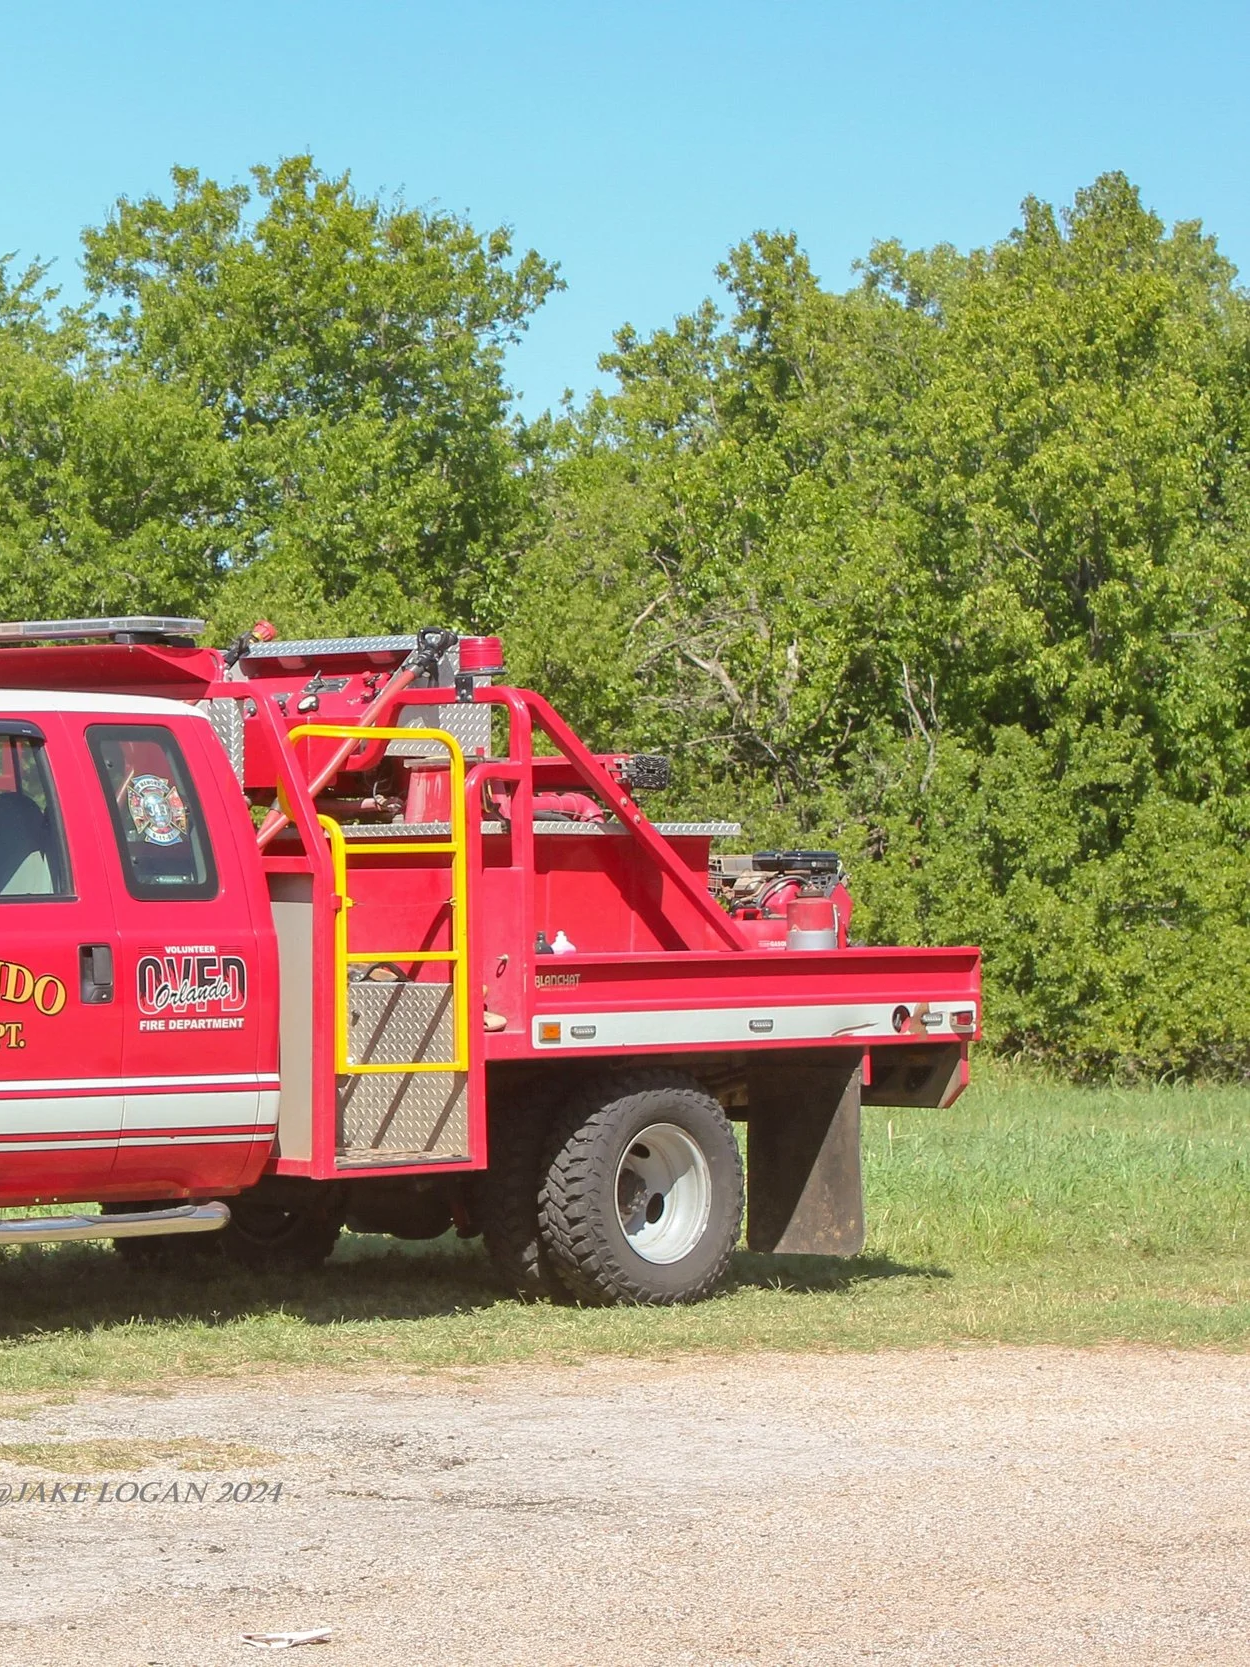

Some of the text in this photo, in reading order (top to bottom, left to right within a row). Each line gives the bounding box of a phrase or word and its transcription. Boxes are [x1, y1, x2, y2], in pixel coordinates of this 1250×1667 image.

[148, 804, 168, 817] 343
[165, 945, 216, 955] VOLUNTEER
[137, 956, 248, 1015] OVFD
[534, 973, 581, 989] BLANCHAT
[154, 974, 231, 1009] Orlando
[139, 1018, 245, 1031] FIRE DEPARTMENT
